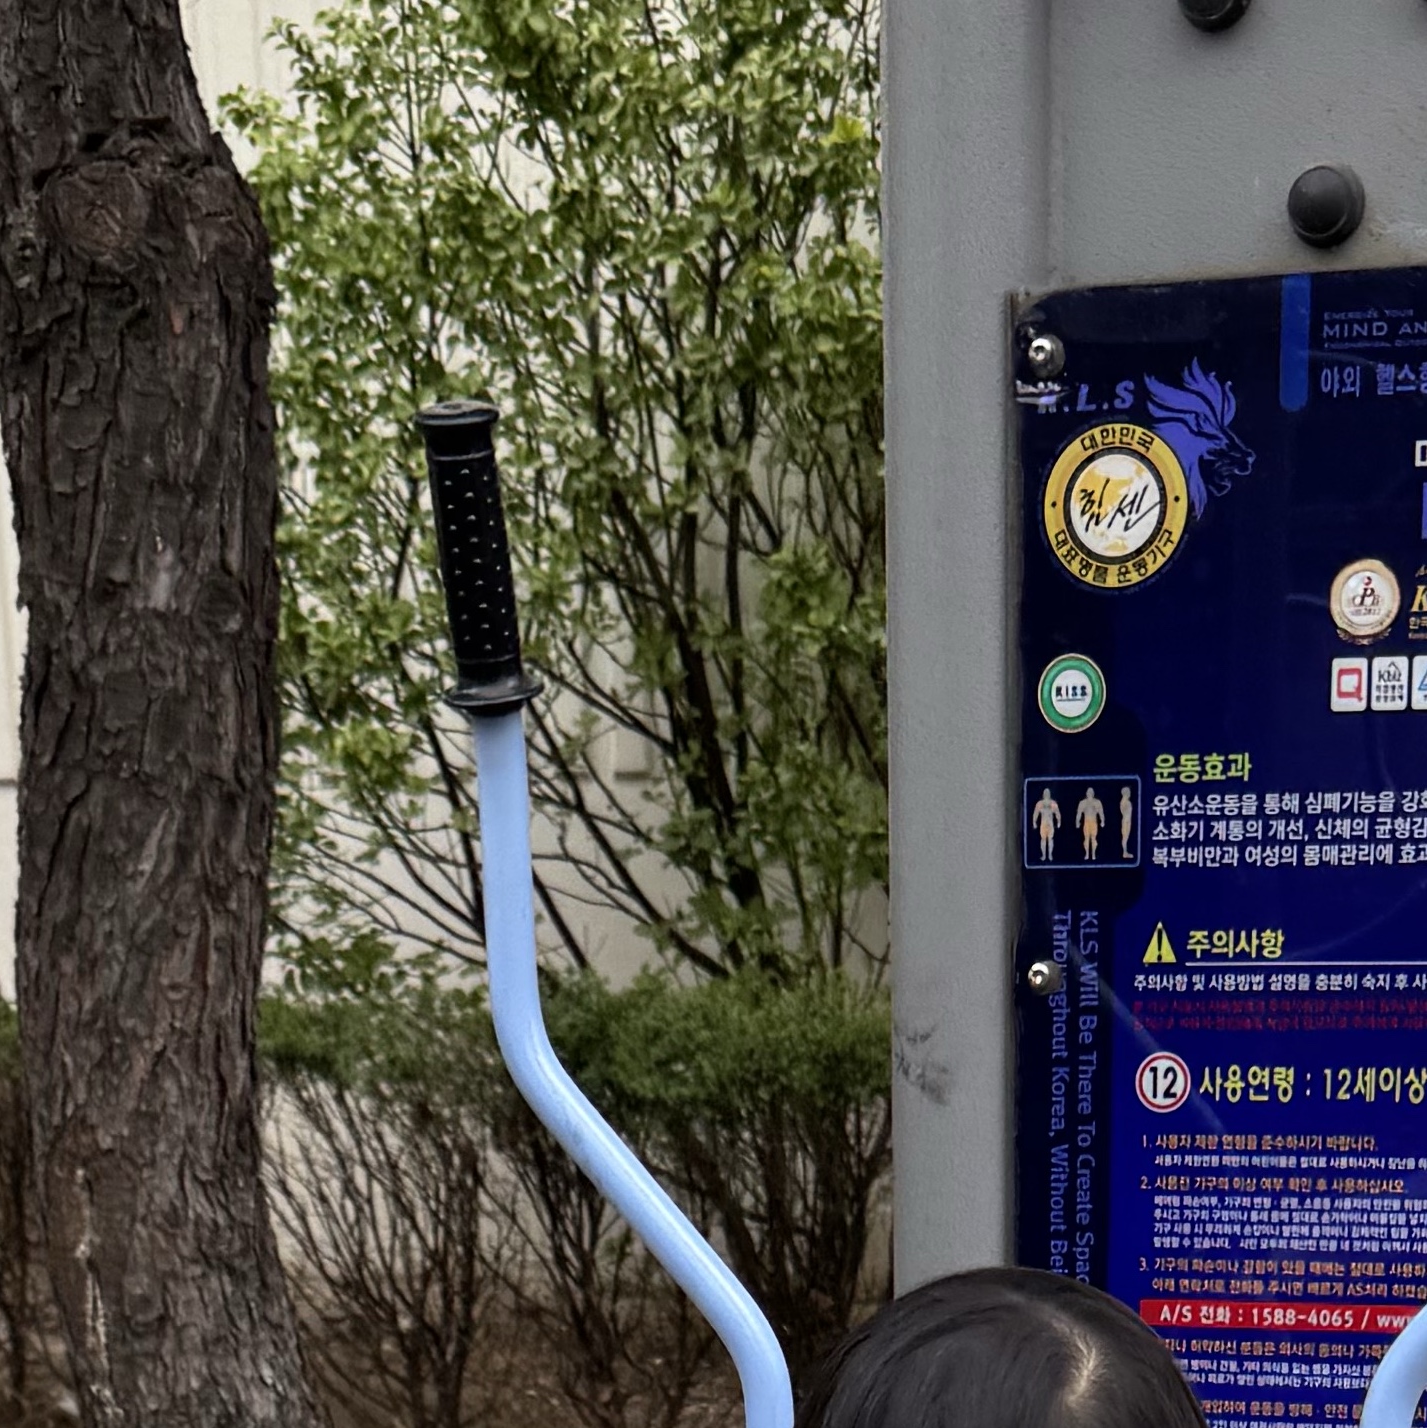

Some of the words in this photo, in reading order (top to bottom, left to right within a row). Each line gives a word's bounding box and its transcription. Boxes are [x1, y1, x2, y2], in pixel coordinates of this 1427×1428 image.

[1323, 321, 1388, 338] MIND
[1321, 366, 1360, 398] 야외
[1079, 426, 1156, 453] 대한민국
[1116, 529, 1175, 584] 운동기구
[1154, 754, 1252, 782] 운동효과
[1153, 794, 1258, 815] 유산소운동을
[1264, 793, 1299, 814] 통해
[1305, 791, 1395, 813] 심폐기능을
[1152, 821, 1203, 841] 소화기
[1210, 820, 1262, 841] 계통의
[1269, 819, 1308, 840] 개선,
[1315, 818, 1368, 839] 신체의
[1153, 846, 1239, 867] 복부비만과
[1245, 845, 1297, 866] 여성의
[1304, 844, 1393, 865] 몸매관리에
[1079, 911, 1099, 955] KLS
[1187, 930, 1284, 958] 주의사항
[1078, 960, 1099, 1008] Will
[1134, 975, 1187, 991] 주의사항
[1192, 975, 1204, 991] 및
[1209, 974, 1264, 991] 사용방법
[1269, 974, 1310, 991] 설명을
[1316, 974, 1357, 990] 충분히
[1362, 974, 1390, 990] 숙지
[1395, 974, 1408, 990] 후
[1078, 1013, 1098, 1045] Be
[1077, 1050, 1097, 1116] There
[1148, 1066, 1178, 1100] 12
[1200, 1066, 1294, 1102] 사용연령
[1324, 1068, 1427, 1103] 12세이상
[1048, 1066, 1071, 1139] Korea,
[1077, 1120, 1096, 1148] To
[1049, 1142, 1070, 1233] Without
[1076, 1153, 1095, 1227] Create
[1075, 1231, 1095, 1284] Spac
[1160, 1304, 1193, 1323] A/S
[1199, 1306, 1231, 1325] 전화
[1252, 1307, 1354, 1329] 1588-4065
